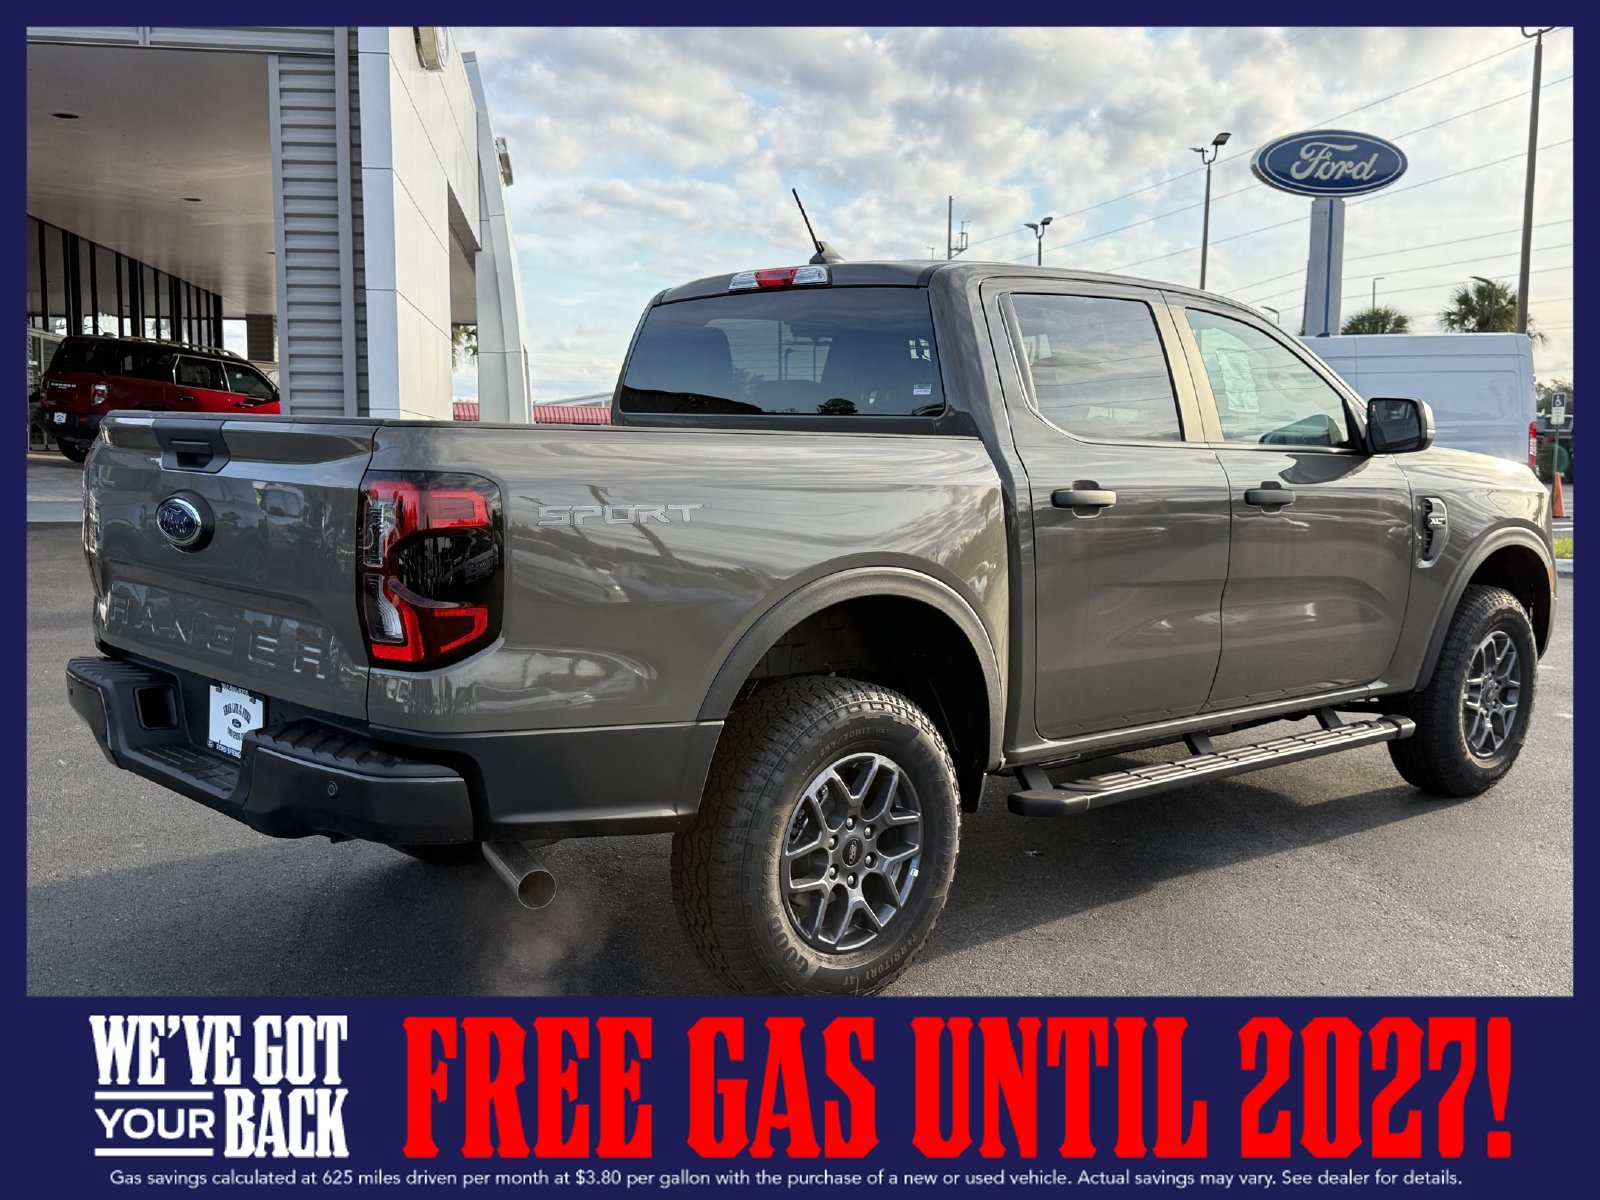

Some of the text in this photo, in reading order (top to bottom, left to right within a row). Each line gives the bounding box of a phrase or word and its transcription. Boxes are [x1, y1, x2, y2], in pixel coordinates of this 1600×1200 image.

[1290, 142, 1379, 181] Ford
[159, 507, 188, 534] Ford
[537, 503, 705, 526] SPORT
[107, 588, 326, 680] RANGER
